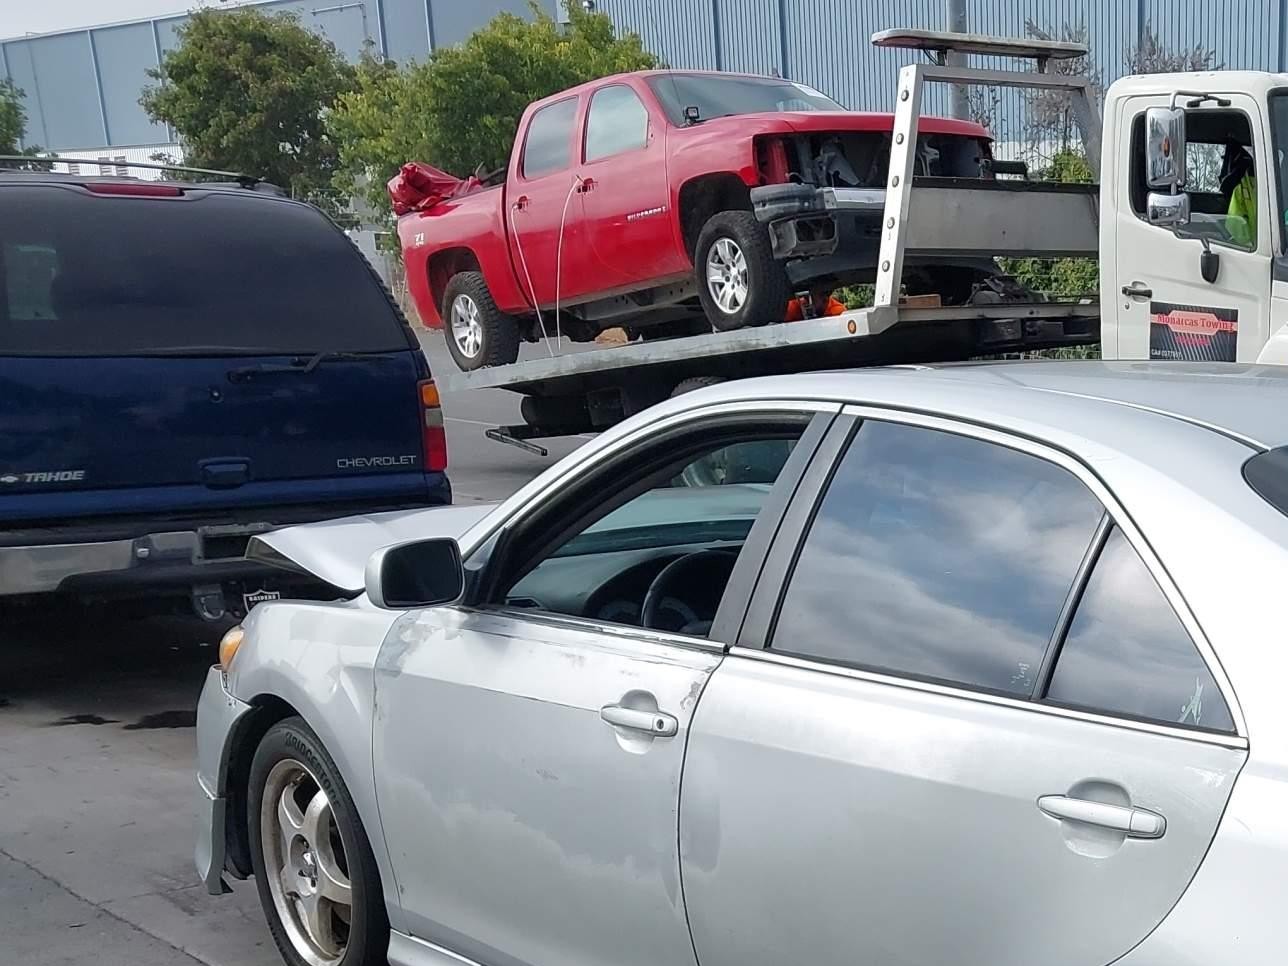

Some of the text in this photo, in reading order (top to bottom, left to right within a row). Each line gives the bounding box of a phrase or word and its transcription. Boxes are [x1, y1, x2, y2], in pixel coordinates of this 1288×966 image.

[1157, 314, 1233, 332] Monarcas Towing
[336, 455, 417, 468] CHEVROLET
[24, 470, 86, 482] TAHOE
[286, 731, 341, 807] BRIDGESTONE
